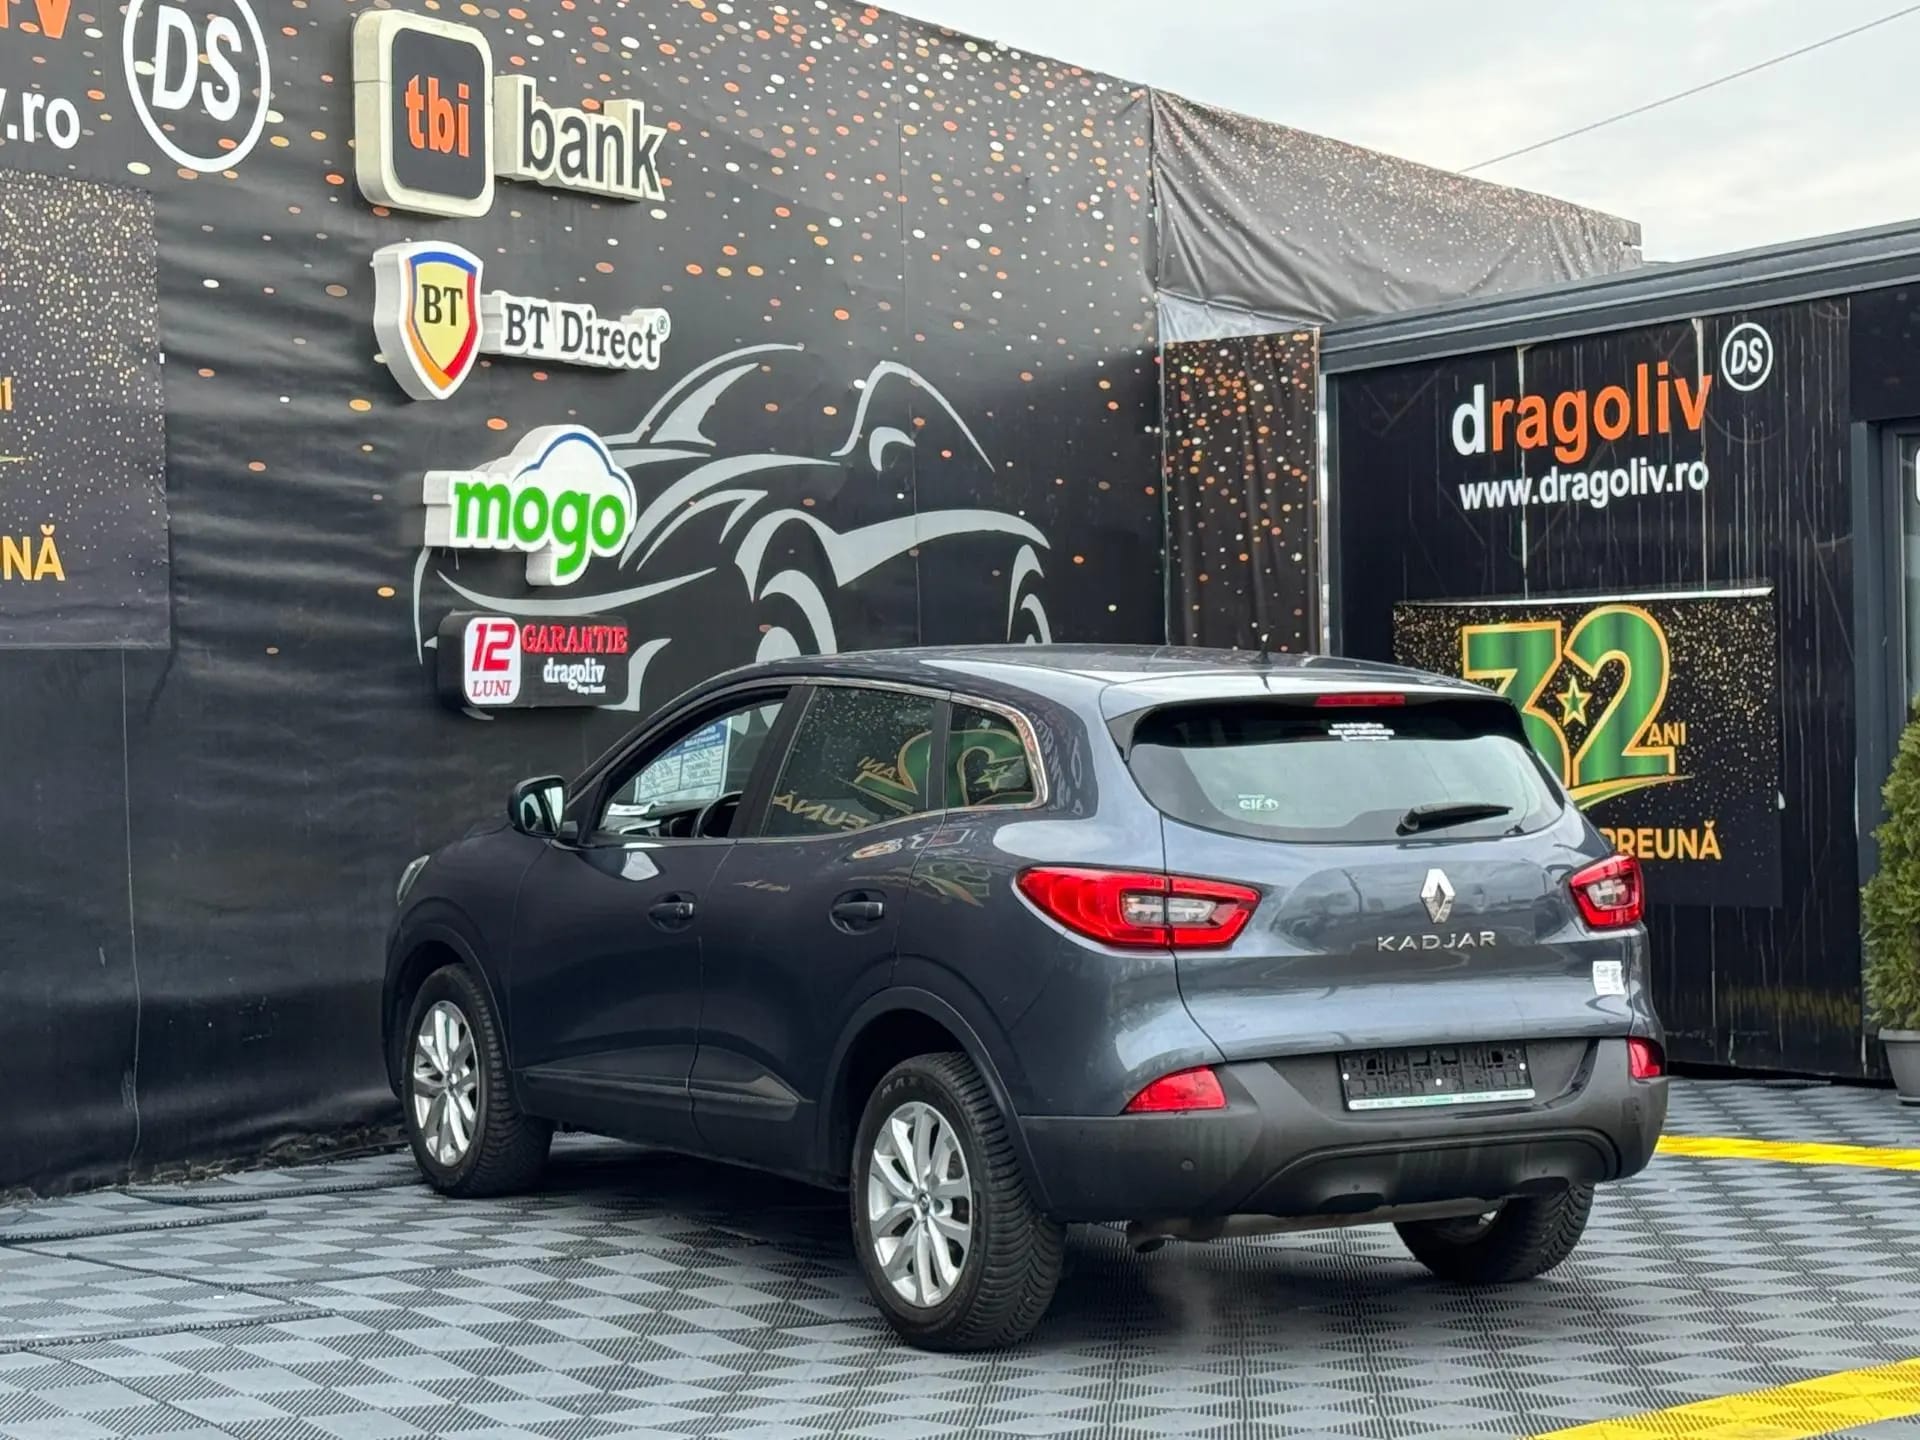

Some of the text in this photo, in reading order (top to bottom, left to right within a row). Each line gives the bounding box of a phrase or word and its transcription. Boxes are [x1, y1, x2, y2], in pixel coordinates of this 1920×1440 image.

[152, 4, 243, 122] DS
[404, 73, 658, 194] tbi bank
[421, 283, 464, 327] BT
[505, 302, 550, 350] BT
[1730, 336, 1764, 376] DS
[1451, 360, 1713, 464] dragoliv
[1459, 456, 1710, 511] www.dragoliv.ro
[453, 481, 627, 578] mogo
[471, 623, 516, 672] 12
[521, 624, 629, 655] GARANTIE
[471, 679, 512, 698] LUNI
[543, 657, 606, 691] dragoliv
[1462, 604, 1676, 790] 32
[1646, 721, 1687, 746] ANI
[1377, 930, 1496, 952] KADJAR
